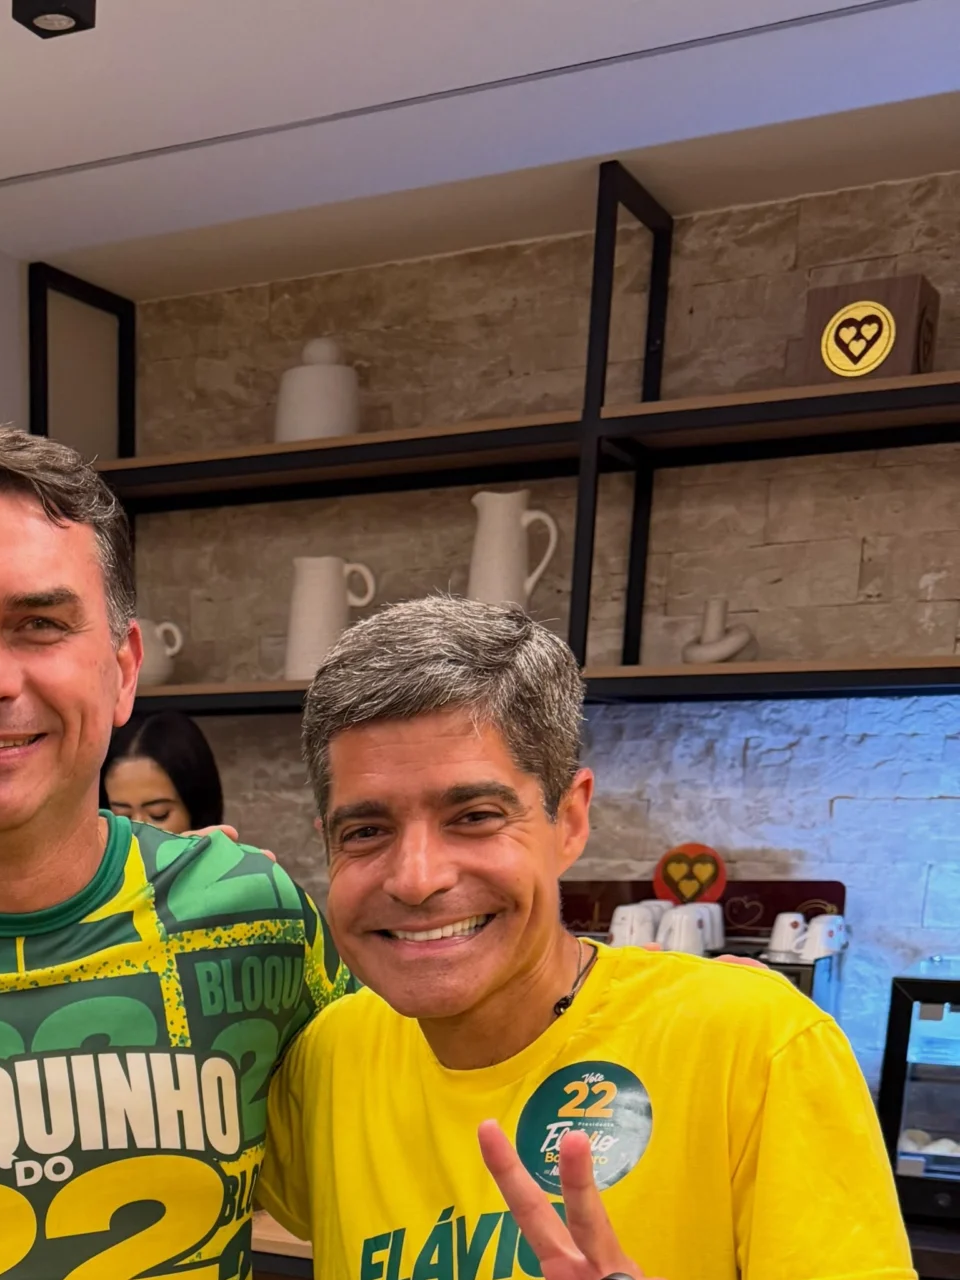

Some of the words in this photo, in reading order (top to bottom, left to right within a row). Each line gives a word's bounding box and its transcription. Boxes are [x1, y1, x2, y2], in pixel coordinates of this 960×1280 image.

[581, 1072, 605, 1084] Vote
[557, 1081, 617, 1118] 22
[14, 1155, 74, 1188] DO
